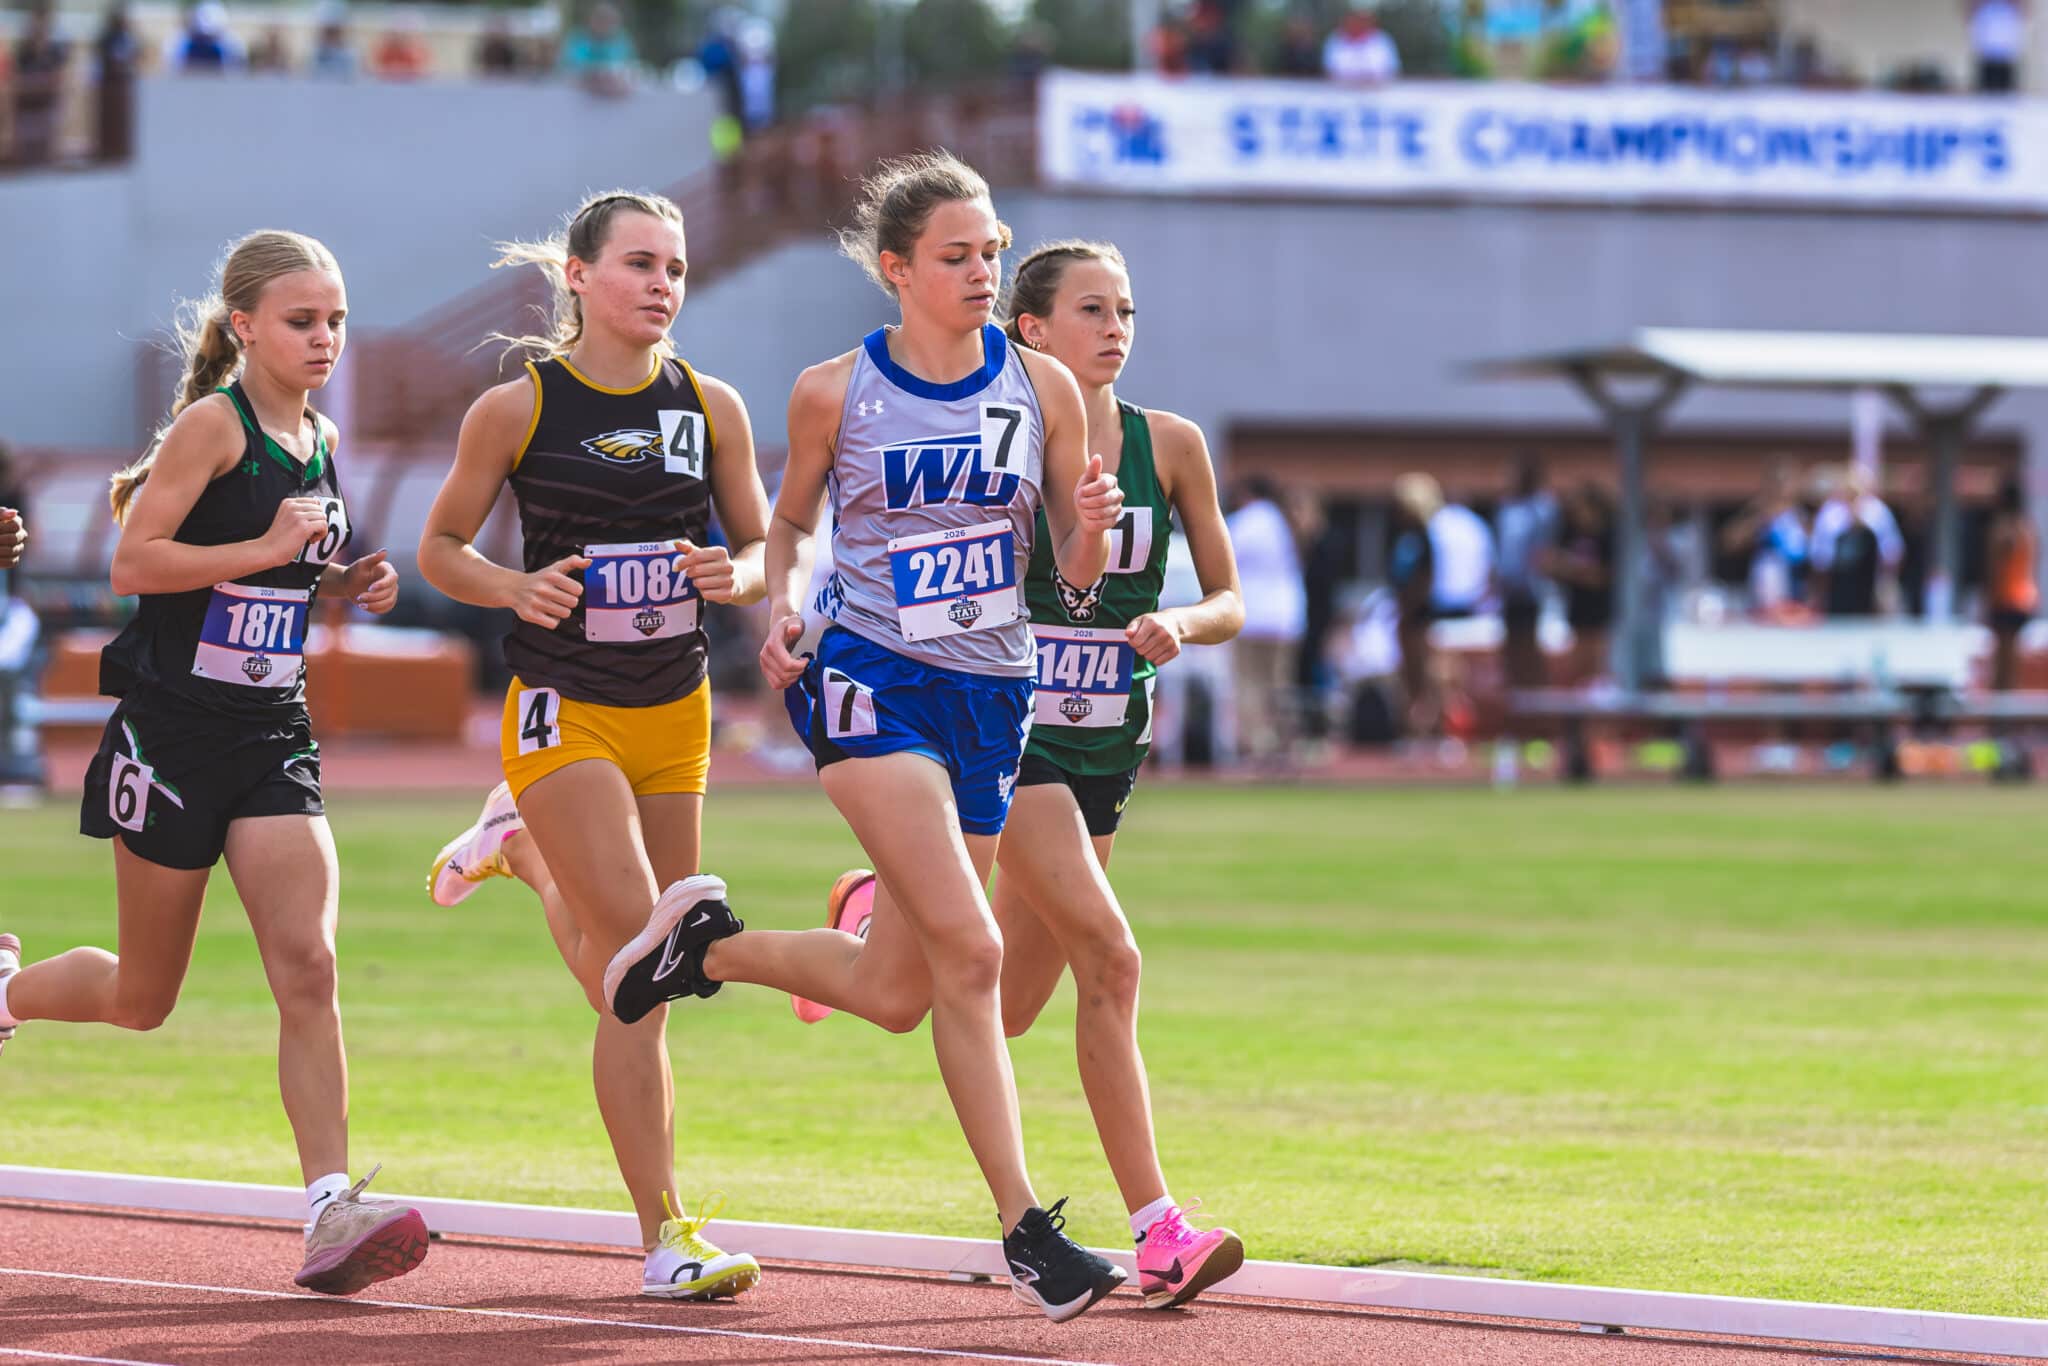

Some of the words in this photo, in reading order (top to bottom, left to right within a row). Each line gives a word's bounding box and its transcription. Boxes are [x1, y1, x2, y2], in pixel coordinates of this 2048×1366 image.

[1232, 107, 1426, 163] STATE
[1458, 108, 2009, 174] CHAMPIONSHIPS
[669, 415, 699, 472] 4
[986, 407, 1023, 468] 7
[317, 501, 340, 561] 6
[638, 544, 659, 552] 2026
[943, 529, 966, 539] 2026
[1110, 511, 1135, 569] 1
[909, 539, 1004, 599] 2241
[227, 602, 295, 649] 1871
[632, 616, 665, 627] STATE
[948, 606, 982, 620] STATE
[1073, 630, 1094, 638] 2026
[242, 662, 273, 673] STATE
[1037, 642, 1119, 689] 1474
[522, 692, 552, 749] 4
[828, 671, 863, 732] 7
[1059, 703, 1092, 713] STATE
[115, 763, 140, 823] 6
